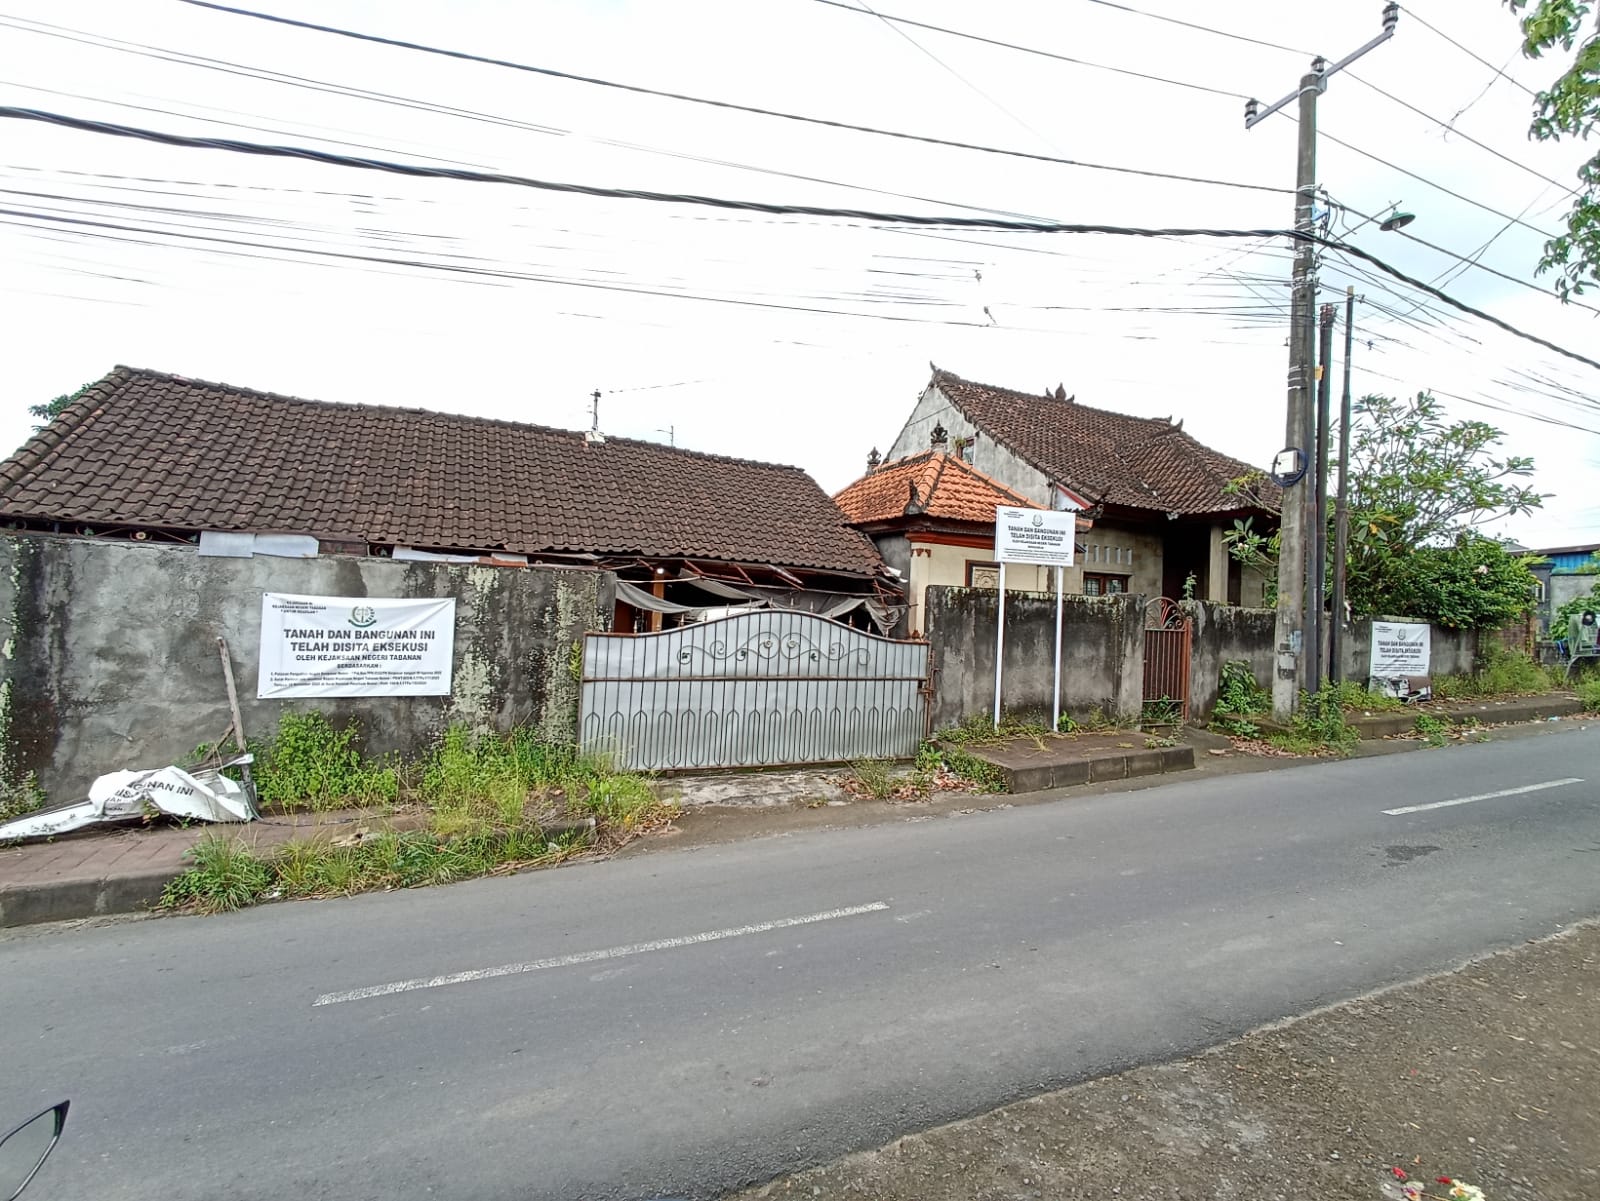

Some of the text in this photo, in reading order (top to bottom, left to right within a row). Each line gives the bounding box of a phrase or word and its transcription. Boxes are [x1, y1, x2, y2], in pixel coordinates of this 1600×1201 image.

[284, 629, 435, 640] TANAH DAN BANGUNAN INI
[290, 642, 428, 652] TELAH DISITA EKSEKUSI
[177, 786, 194, 796] INI
